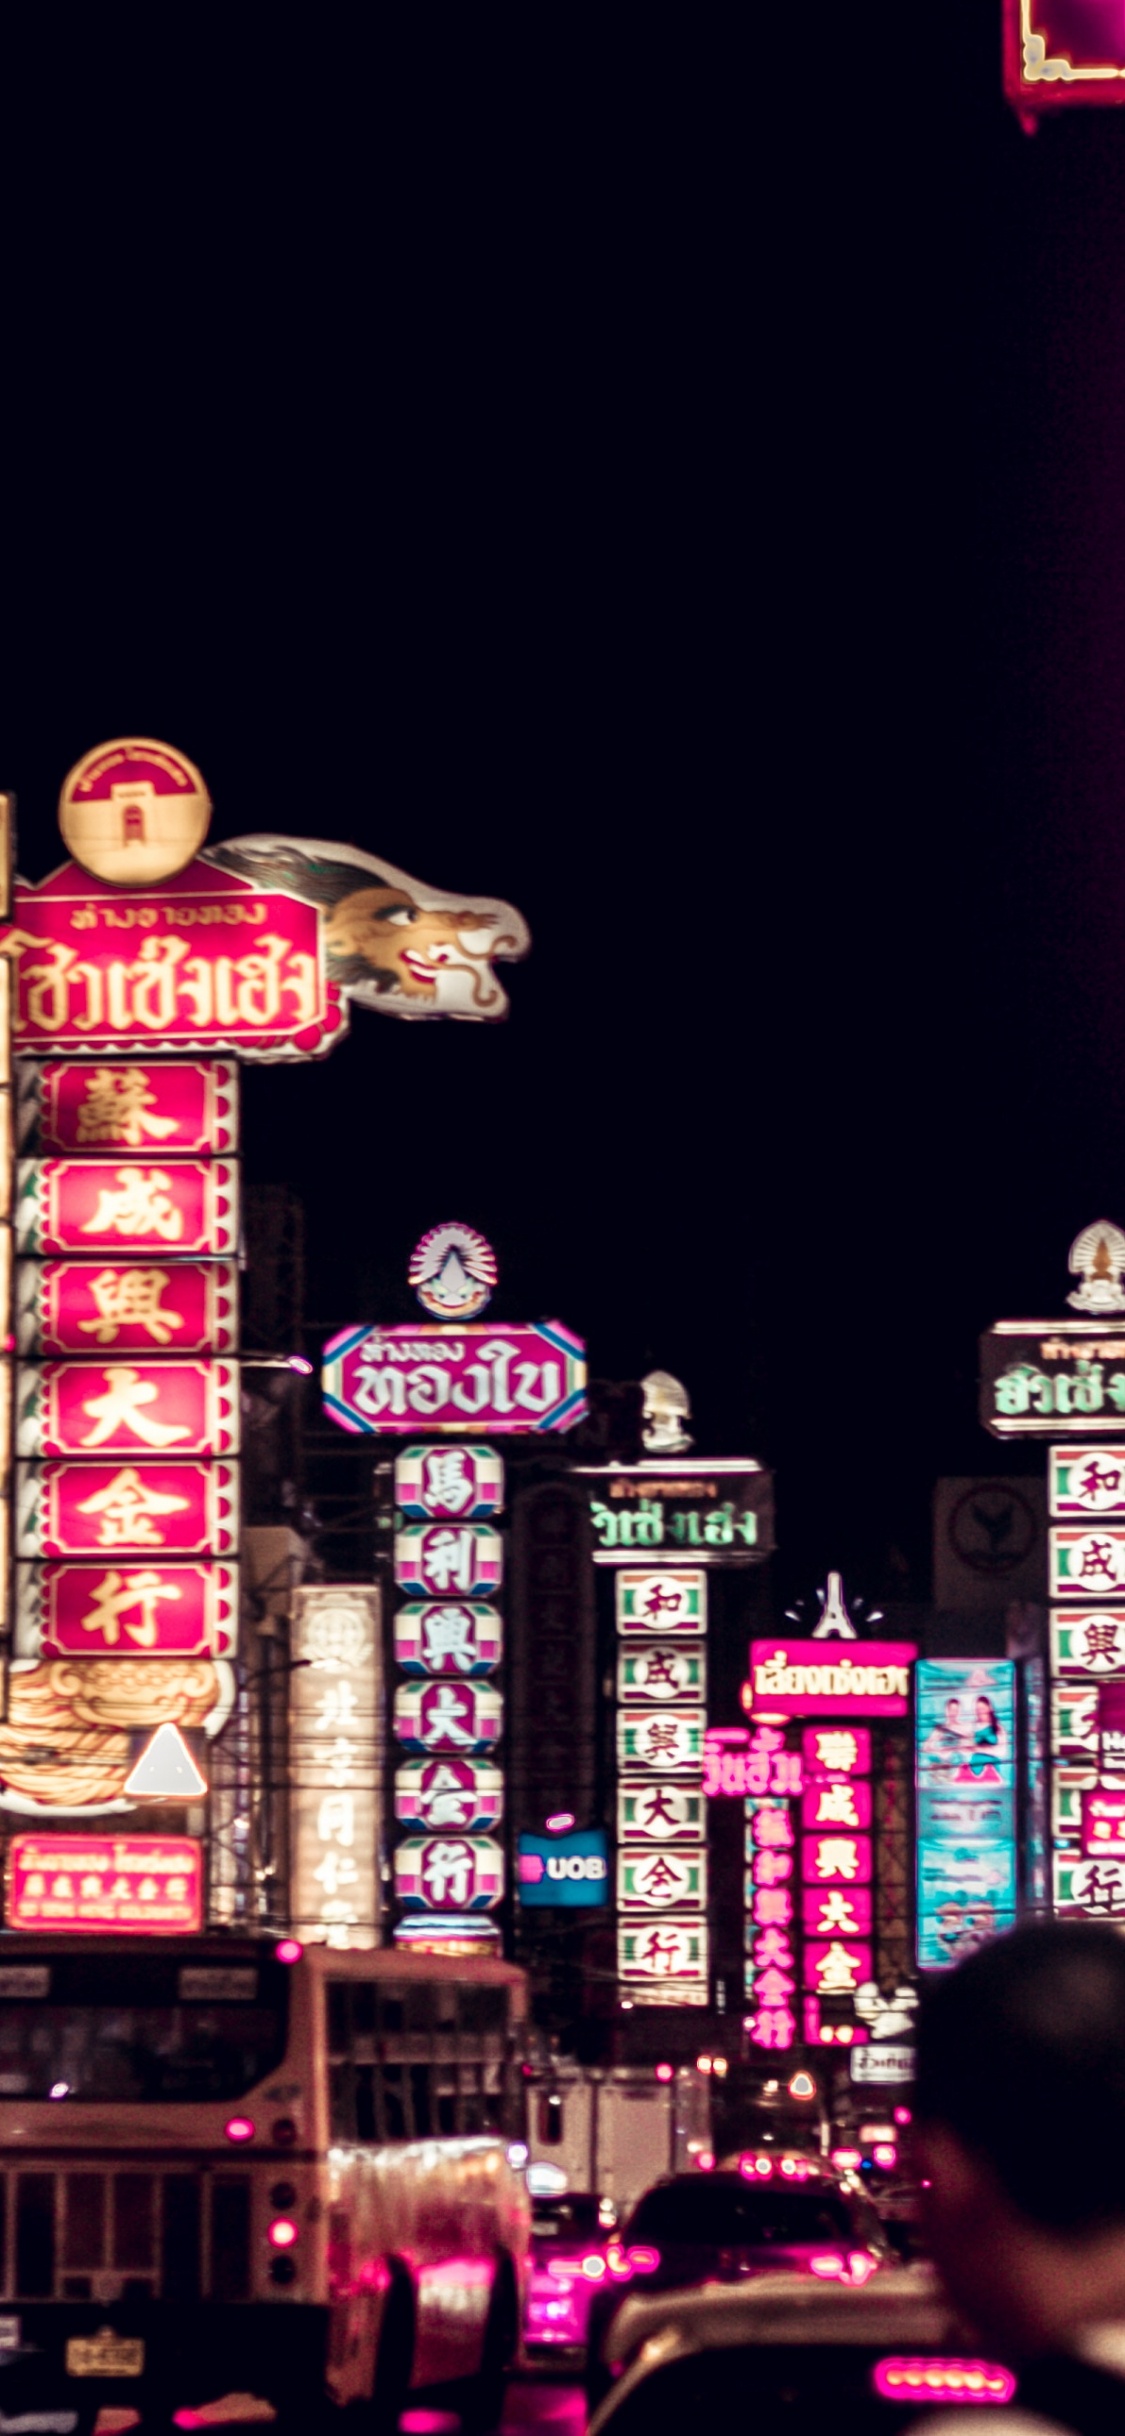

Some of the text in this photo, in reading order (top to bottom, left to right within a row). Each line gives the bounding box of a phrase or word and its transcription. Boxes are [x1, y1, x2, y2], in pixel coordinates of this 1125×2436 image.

[75, 1067, 192, 1648] 蘇成興大金行
[352, 1339, 561, 1415] ทองใบ
[420, 1451, 478, 1901] 馬利興大金行
[547, 1856, 607, 1880] UOB
